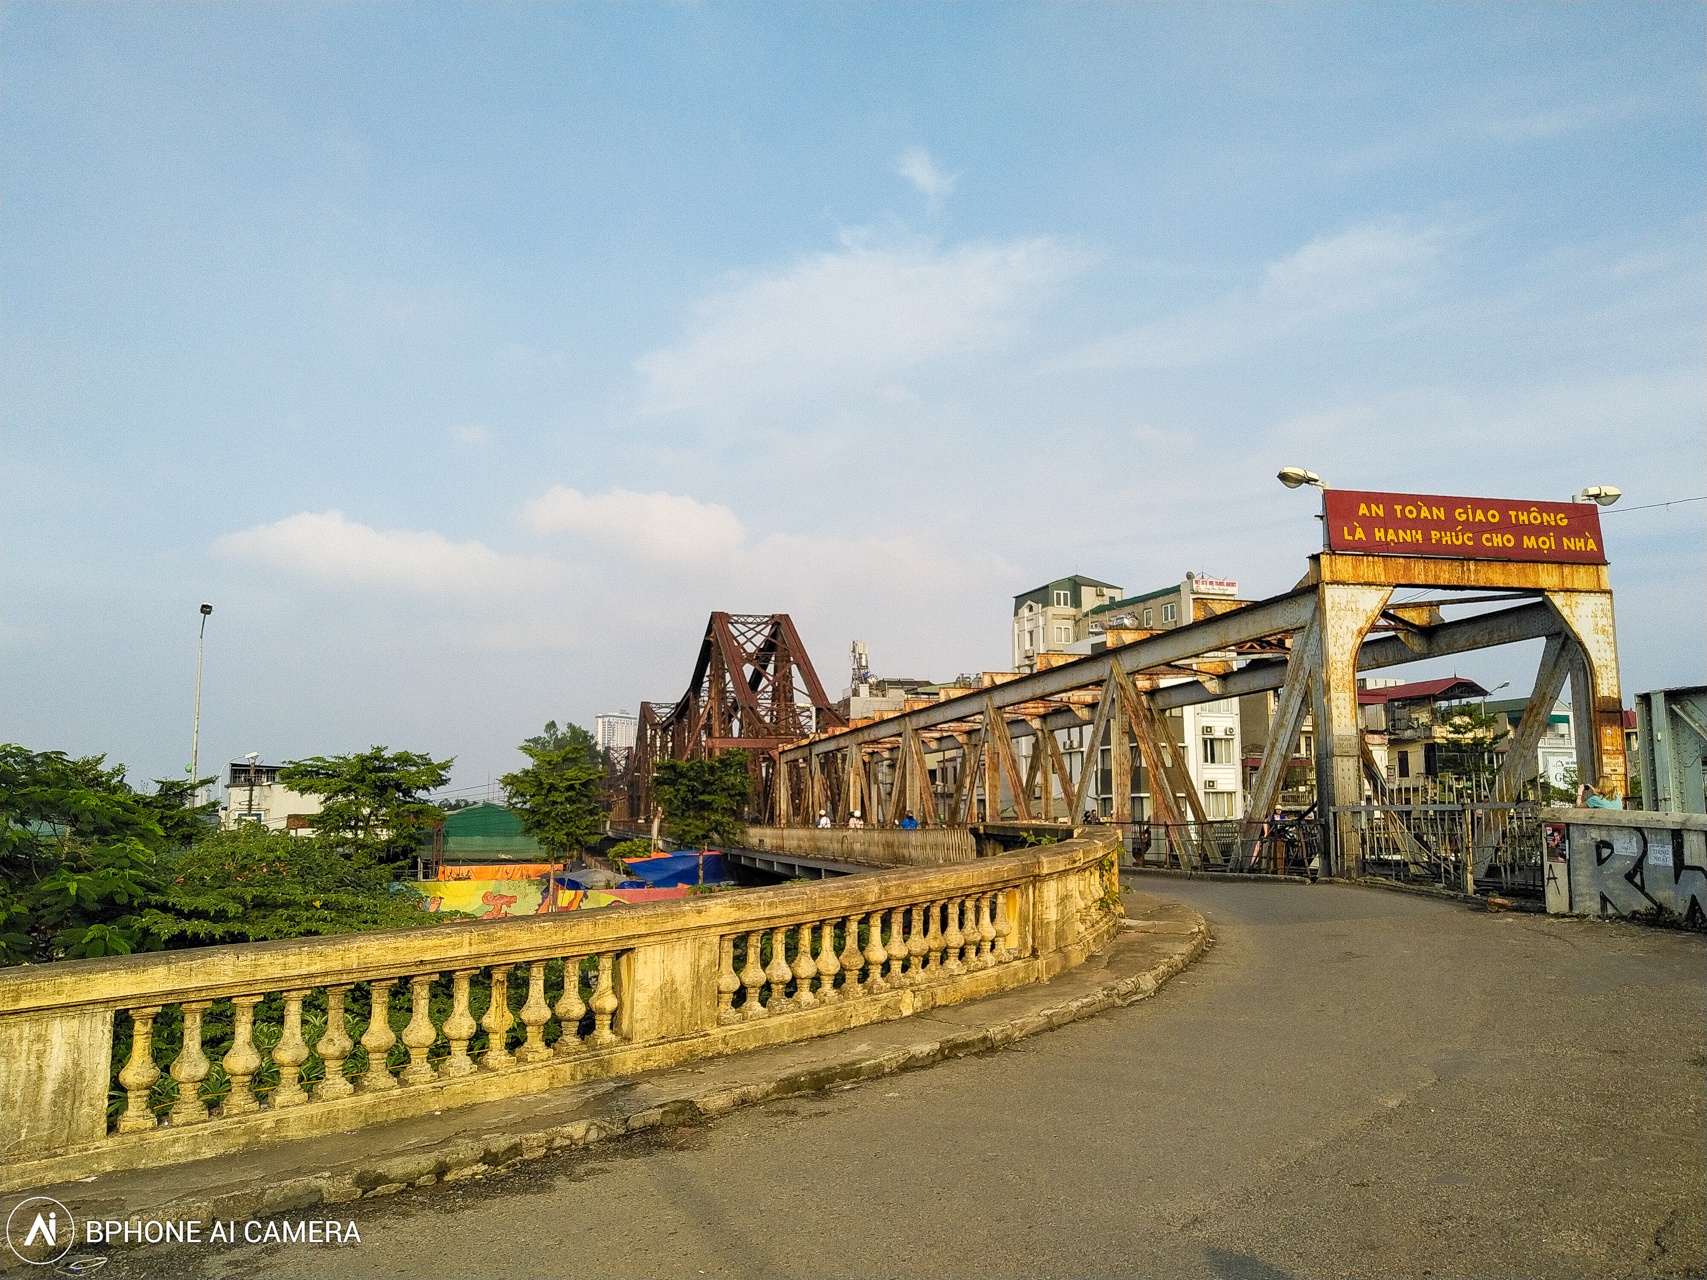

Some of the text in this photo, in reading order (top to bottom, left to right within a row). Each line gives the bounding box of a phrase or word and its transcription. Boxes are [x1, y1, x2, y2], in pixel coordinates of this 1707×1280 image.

[1358, 502, 1385, 518] AN
[1394, 501, 1446, 522] TOÀN
[1508, 507, 1569, 527] THÔNG
[1343, 522, 1367, 542] LÀ
[1374, 527, 1423, 547] HẠNH
[1431, 526, 1474, 547] PHÚC
[1482, 533, 1515, 548] CHO
[1563, 531, 1598, 552] NHÀ
